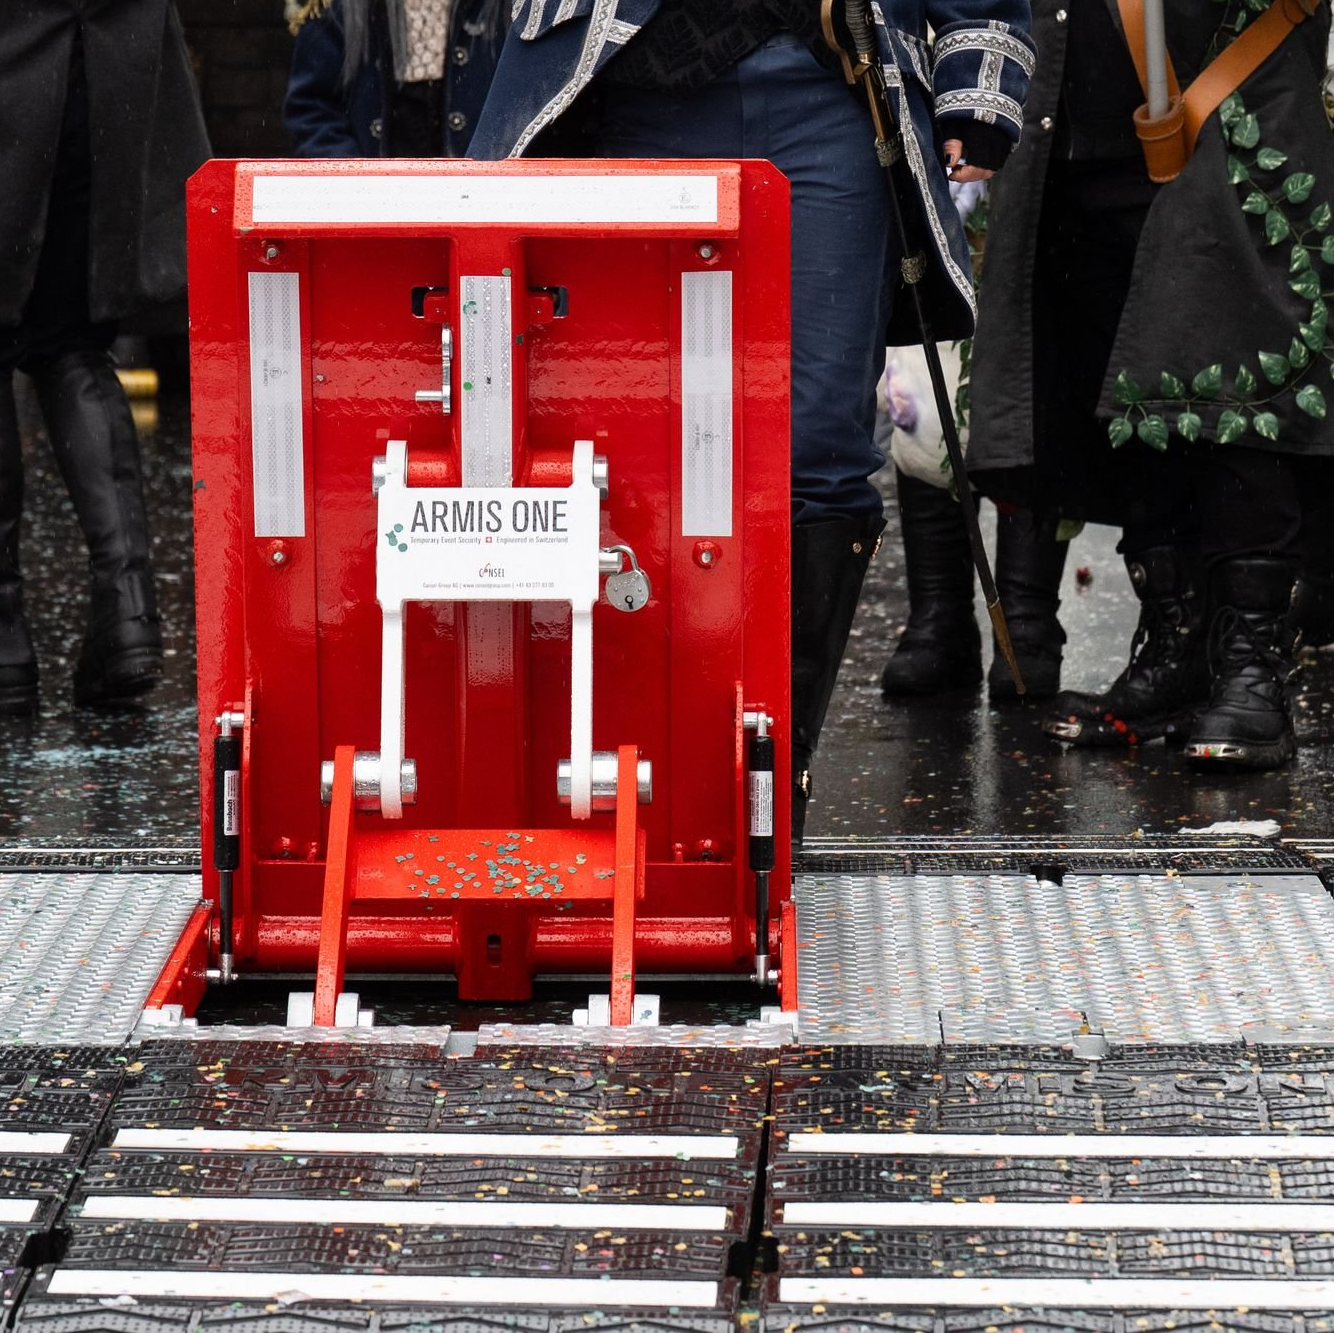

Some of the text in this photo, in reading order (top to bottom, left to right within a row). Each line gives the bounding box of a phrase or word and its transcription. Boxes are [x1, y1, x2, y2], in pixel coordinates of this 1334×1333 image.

[410, 499, 568, 533] ARMIS ONE
[410, 536, 440, 544] Temporary
[441, 536, 457, 544] Event
[458, 536, 481, 545] Security
[496, 536, 528, 544] Engineered
[535, 536, 569, 544] Switzerland
